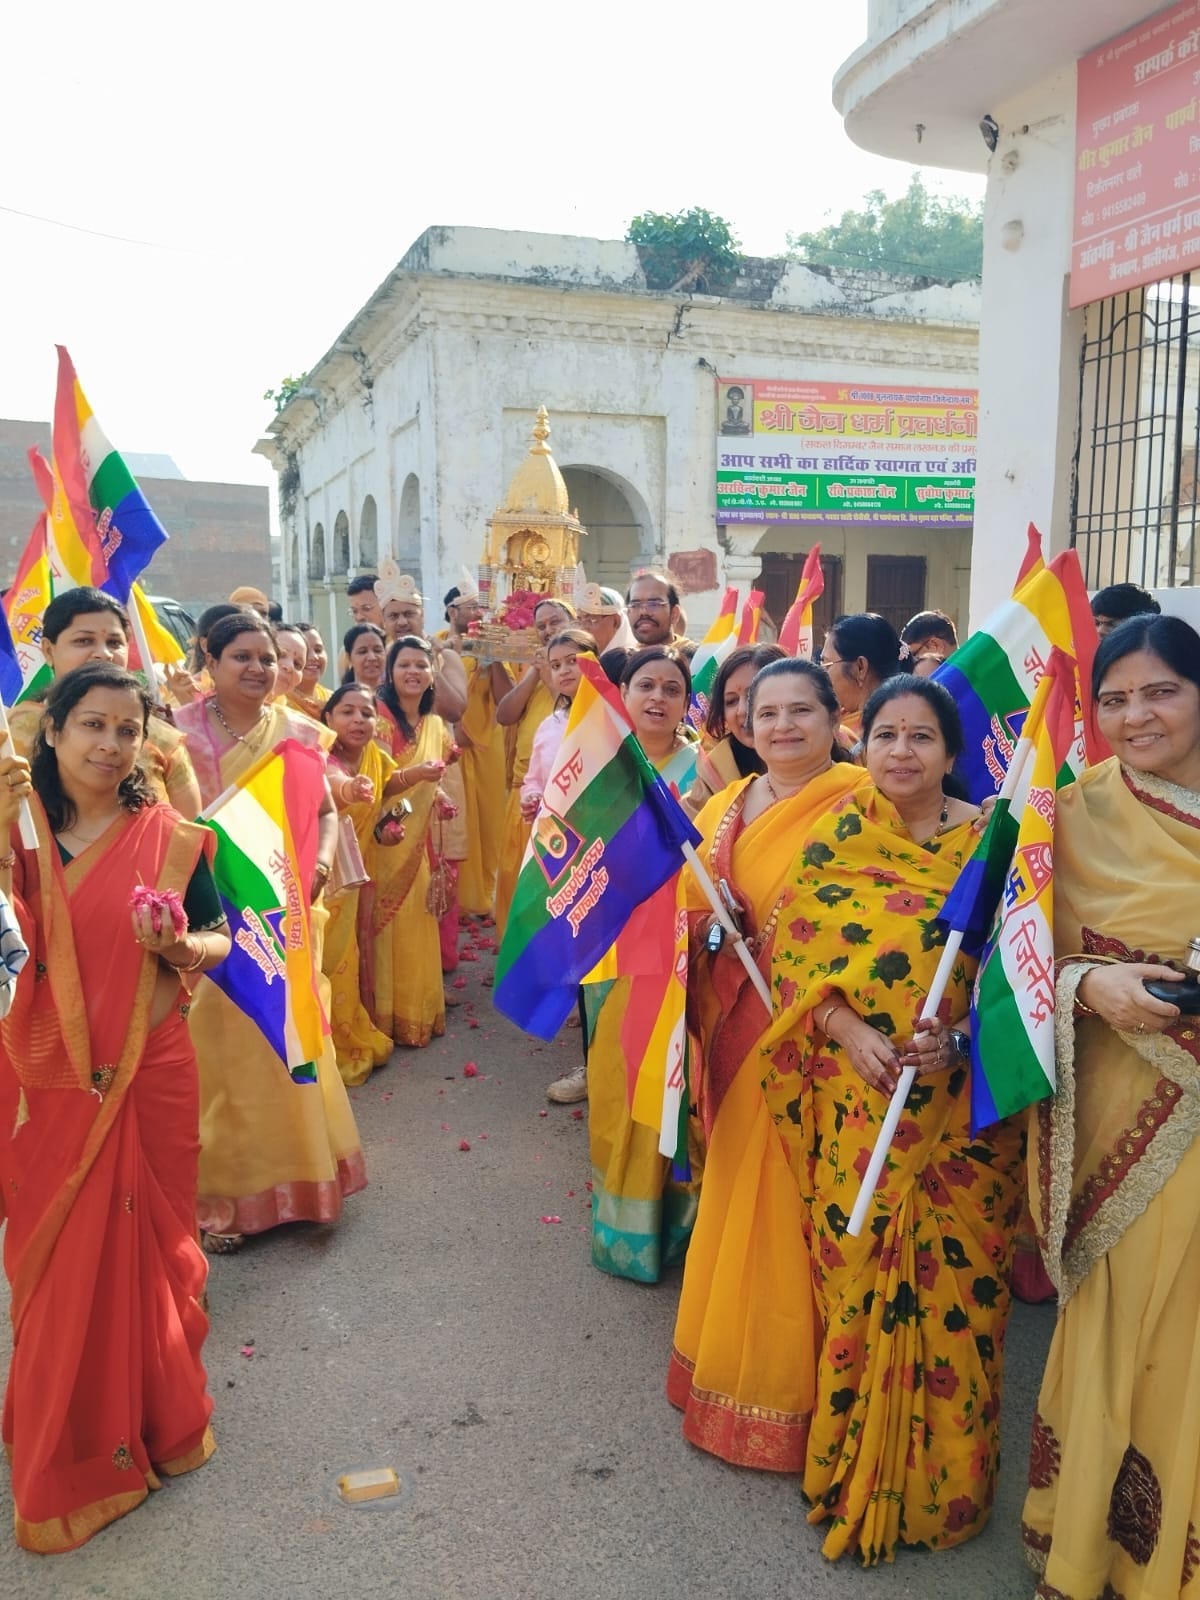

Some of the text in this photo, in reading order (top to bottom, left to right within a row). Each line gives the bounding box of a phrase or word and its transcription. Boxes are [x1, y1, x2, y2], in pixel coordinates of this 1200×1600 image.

[1133, 39, 1175, 82] सम्पर्क
[1131, 121, 1155, 148] जैन
[1124, 227, 1138, 252] श्री
[1140, 222, 1161, 246] जैन
[1162, 208, 1182, 238] धर्म
[759, 401, 797, 430] श्री
[797, 404, 848, 433] जैन
[850, 407, 896, 436] धर्म
[721, 453, 756, 468] आप
[758, 452, 793, 470] सभी
[796, 456, 818, 470] का
[822, 455, 871, 472] हार्दिक
[874, 459, 922, 473] स्वागत
[924, 456, 948, 473] एवं
[717, 480, 808, 499] अरविन्द कुमार जैन
[877, 484, 898, 499] जैन
[943, 487, 971, 503] कुमार
